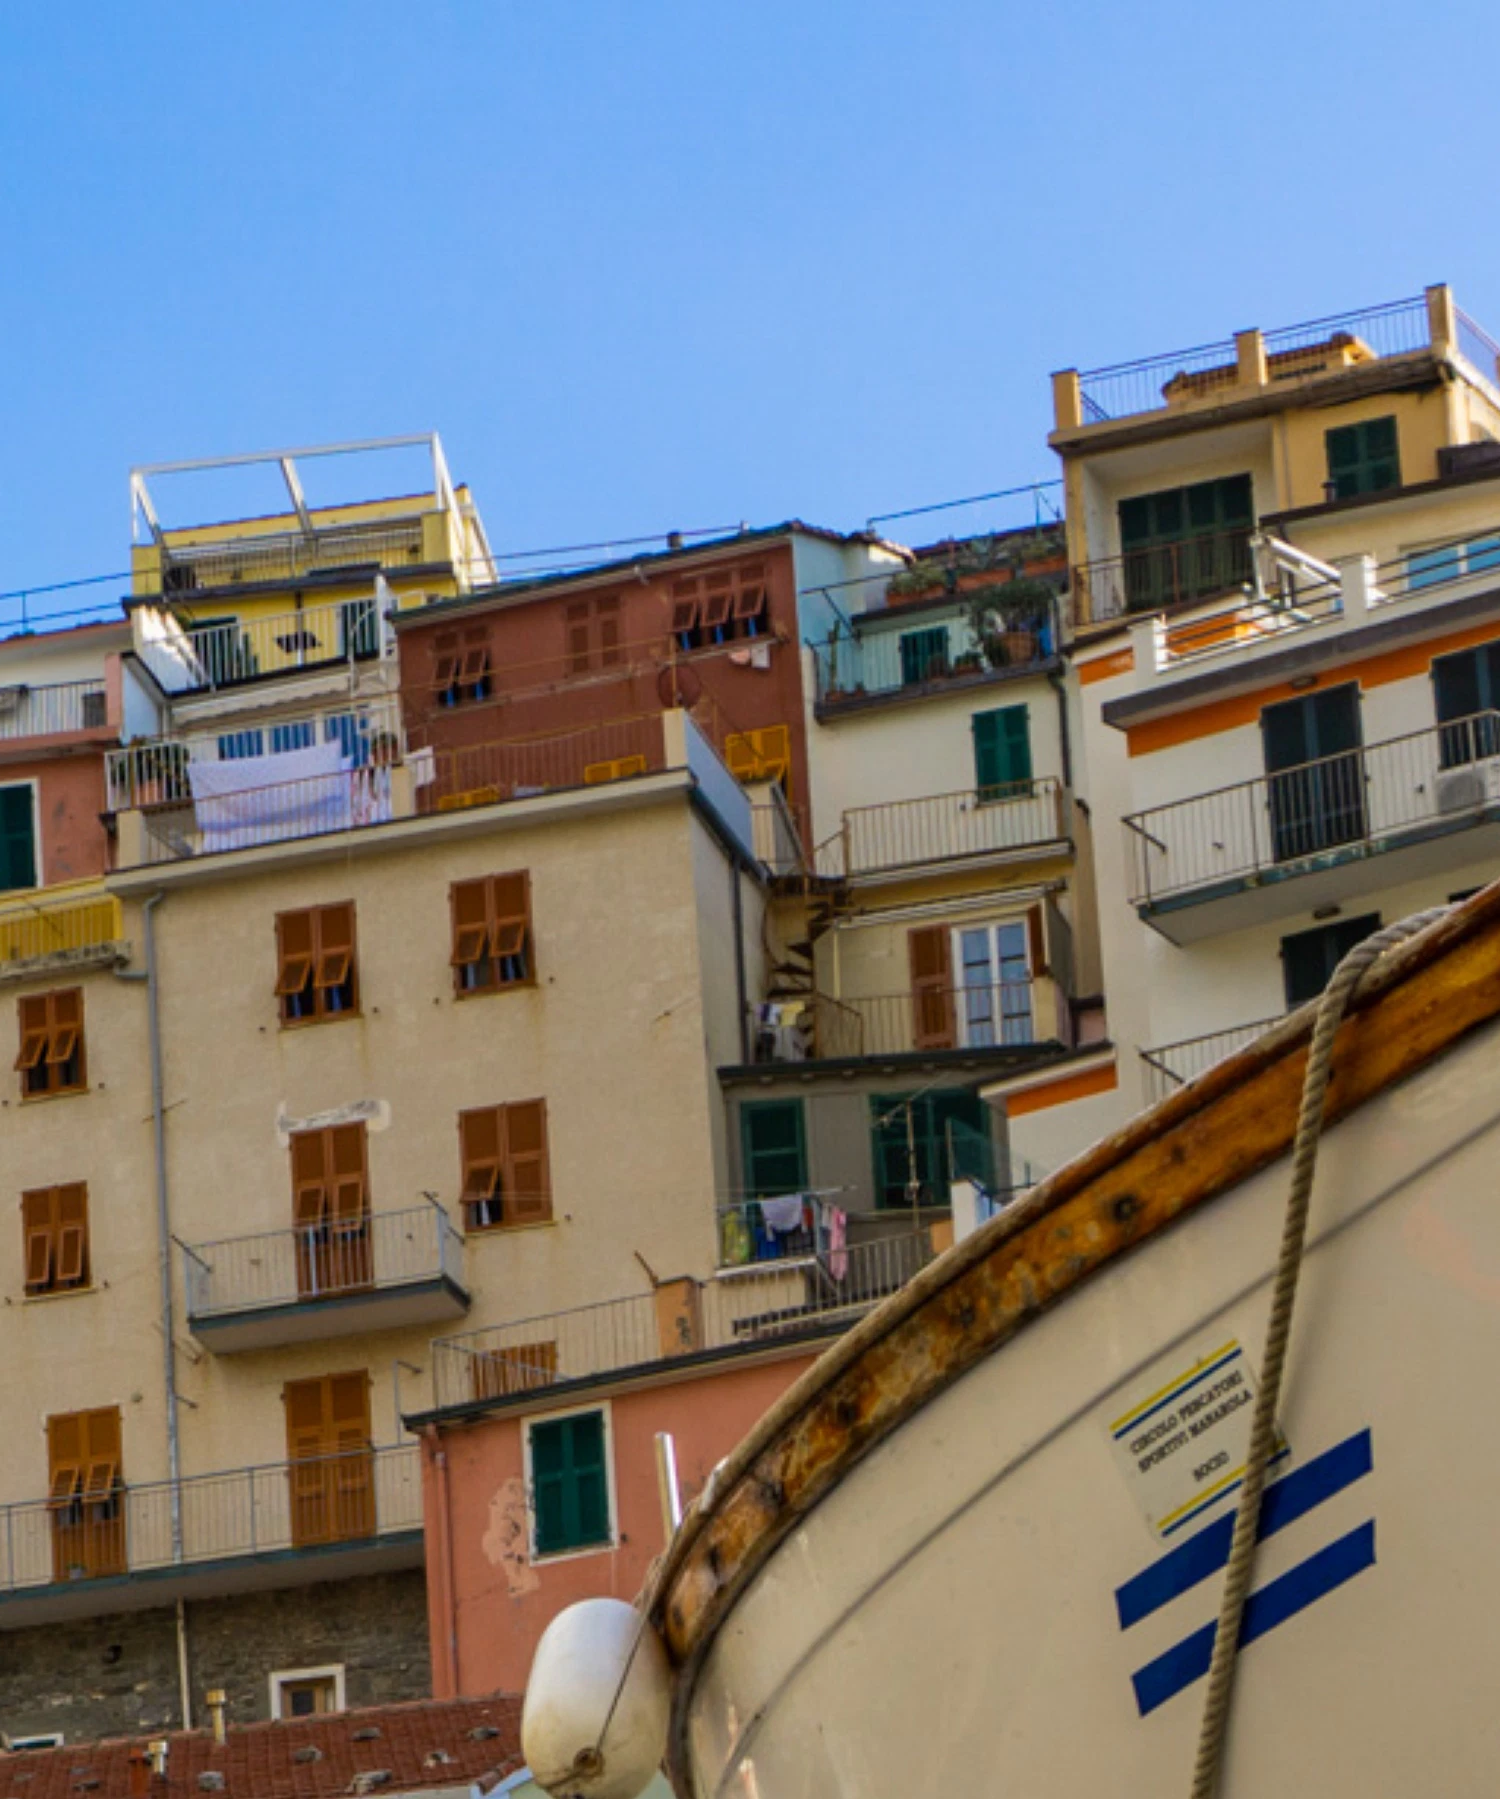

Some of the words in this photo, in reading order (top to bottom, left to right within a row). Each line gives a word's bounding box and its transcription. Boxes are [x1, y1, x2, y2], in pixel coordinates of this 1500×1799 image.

[1130, 1414, 1178, 1453] CIRCOLO
[1179, 1370, 1243, 1421] PESCATORI
[1138, 1431, 1189, 1473] SPORTIVI
[1189, 1389, 1253, 1437] MANAROLA
[1193, 1452, 1230, 1482] SOCIO
